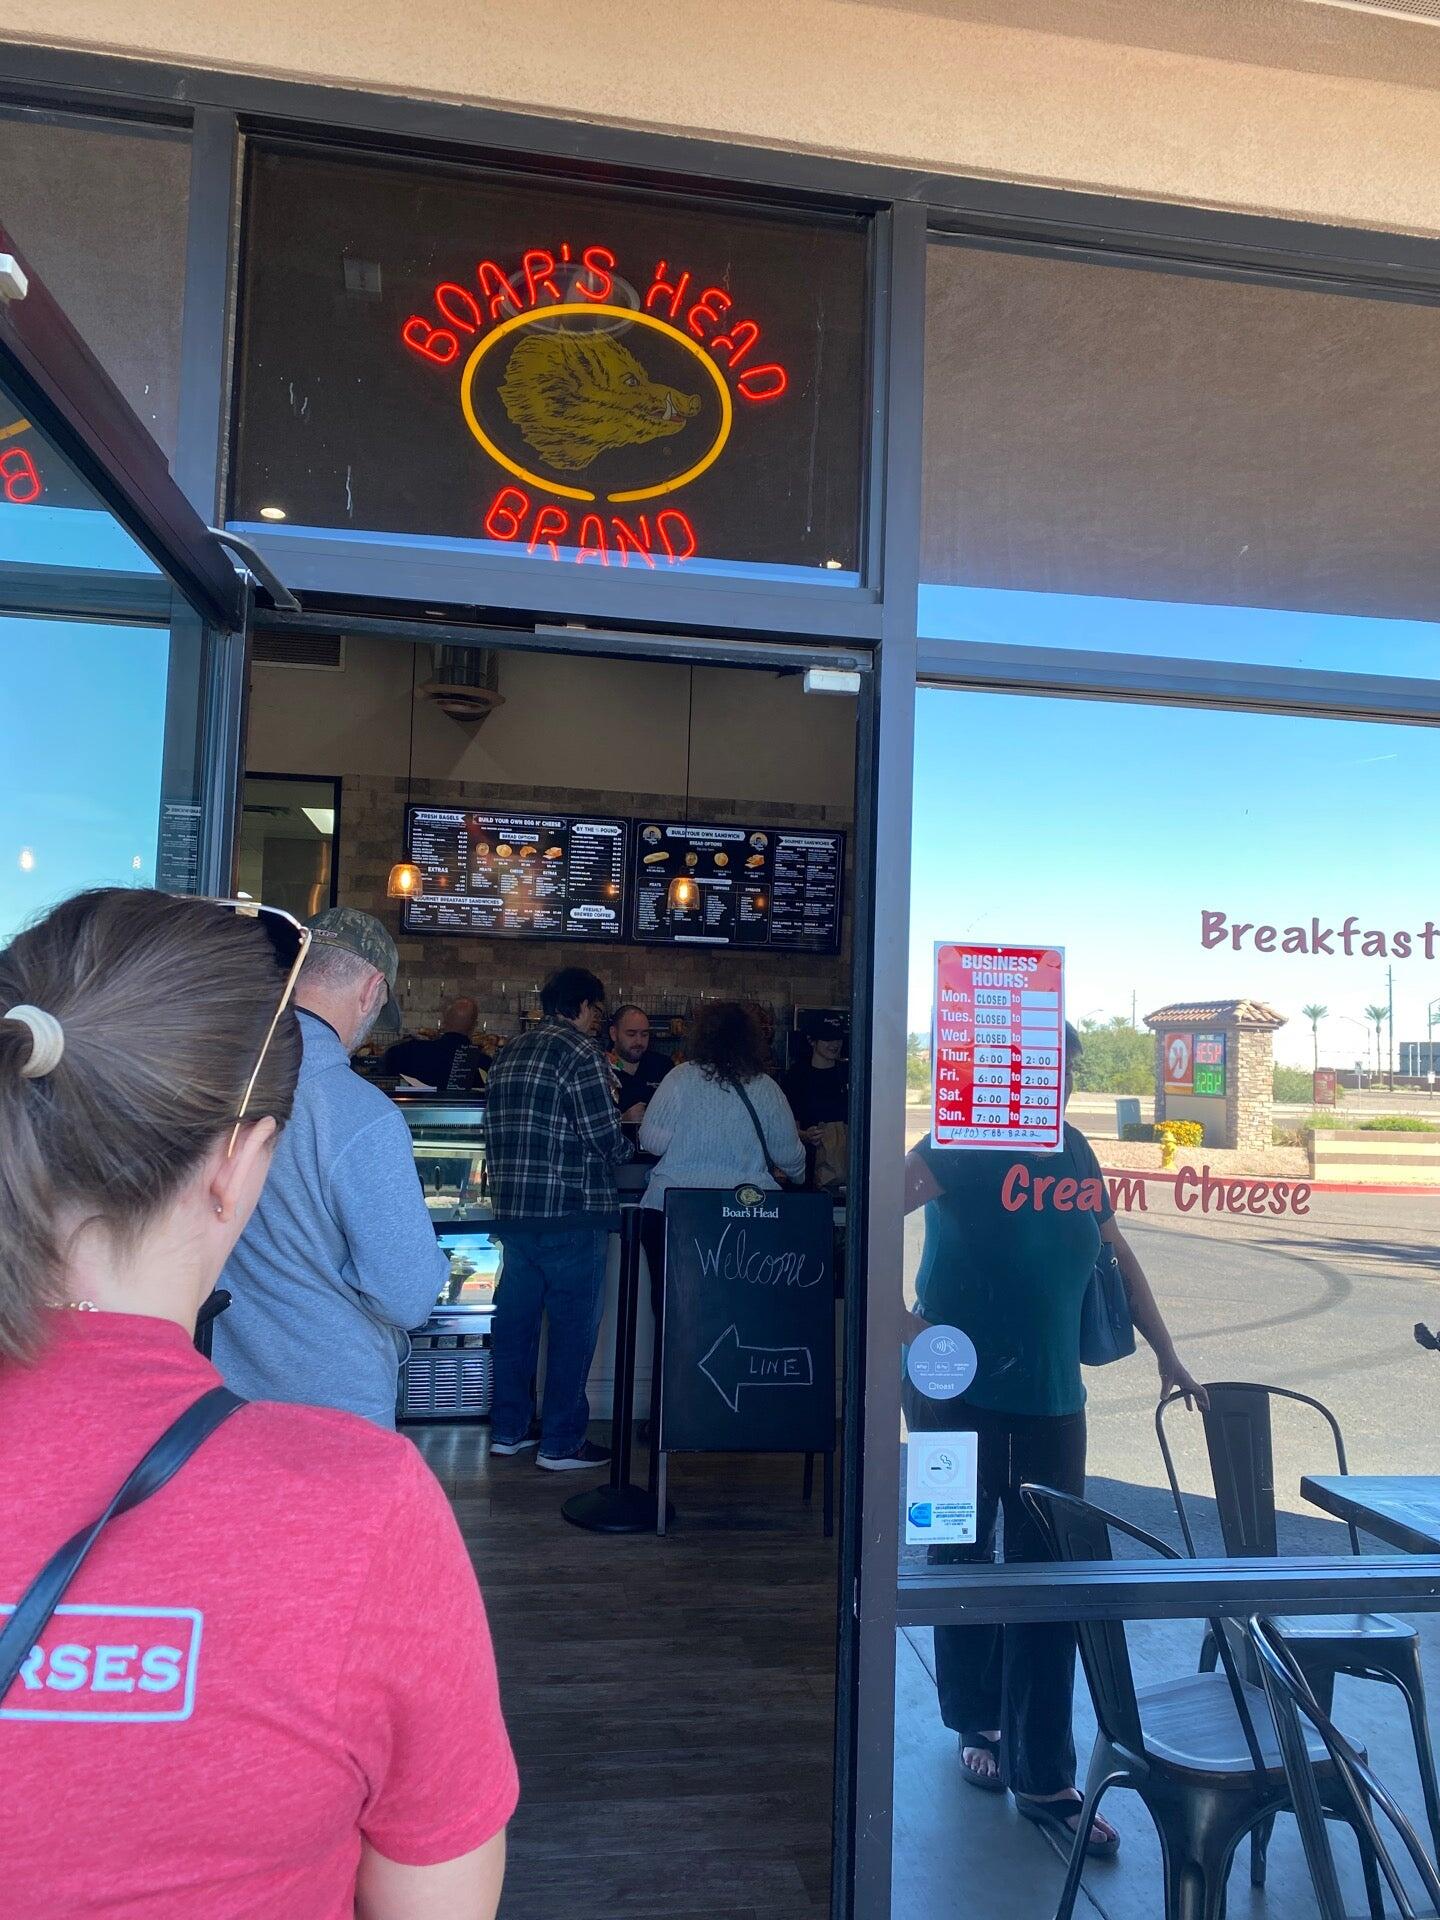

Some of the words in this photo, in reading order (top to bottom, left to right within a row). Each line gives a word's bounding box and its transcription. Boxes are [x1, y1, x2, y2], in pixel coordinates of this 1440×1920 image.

[403, 243, 616, 362] BOAR'S
[647, 260, 788, 400] HEAD
[484, 486, 696, 568] BRAND
[1200, 909, 1440, 960] Breakfast
[961, 954, 1038, 972] BUSINESS
[972, 971, 1029, 988] HOURS:
[941, 990, 971, 1003] Mon.
[976, 993, 1007, 1005] CLOSED
[1011, 994, 1020, 1003] to
[941, 1009, 972, 1022] Tues.
[975, 1014, 1006, 1025] CLOSED
[1011, 1014, 1020, 1023] to
[941, 1029, 971, 1042] Wed.
[975, 1033, 1007, 1044] CLOSED
[1011, 1033, 1020, 1043] to
[941, 1049, 971, 1062] Thur.
[979, 1055, 1003, 1064] 6:00
[1011, 1052, 1021, 1062] to
[1025, 1056, 1050, 1066] 2:00
[940, 1069, 959, 1081] Fri.
[978, 1075, 1003, 1084] 6:00
[1011, 1072, 1020, 1082] to
[1025, 1076, 1049, 1086] 2:00
[939, 1088, 963, 1101] Sat.
[977, 1094, 1002, 1104] 6:00
[1011, 1092, 1020, 1101] to
[1024, 1096, 1049, 1105] 2:00
[938, 1108, 965, 1121] Sun.
[976, 1114, 1001, 1124] 7:00
[1010, 1112, 1019, 1121] to
[1023, 1116, 1048, 1125] 2:00
[1001, 1163, 1149, 1213] Cream
[1174, 1165, 1312, 1216] Cheese
[722, 1206, 751, 1218] Boar's
[753, 1207, 779, 1219] Head
[695, 1223, 825, 1288] Welcome
[750, 1357, 800, 1377] LINE
